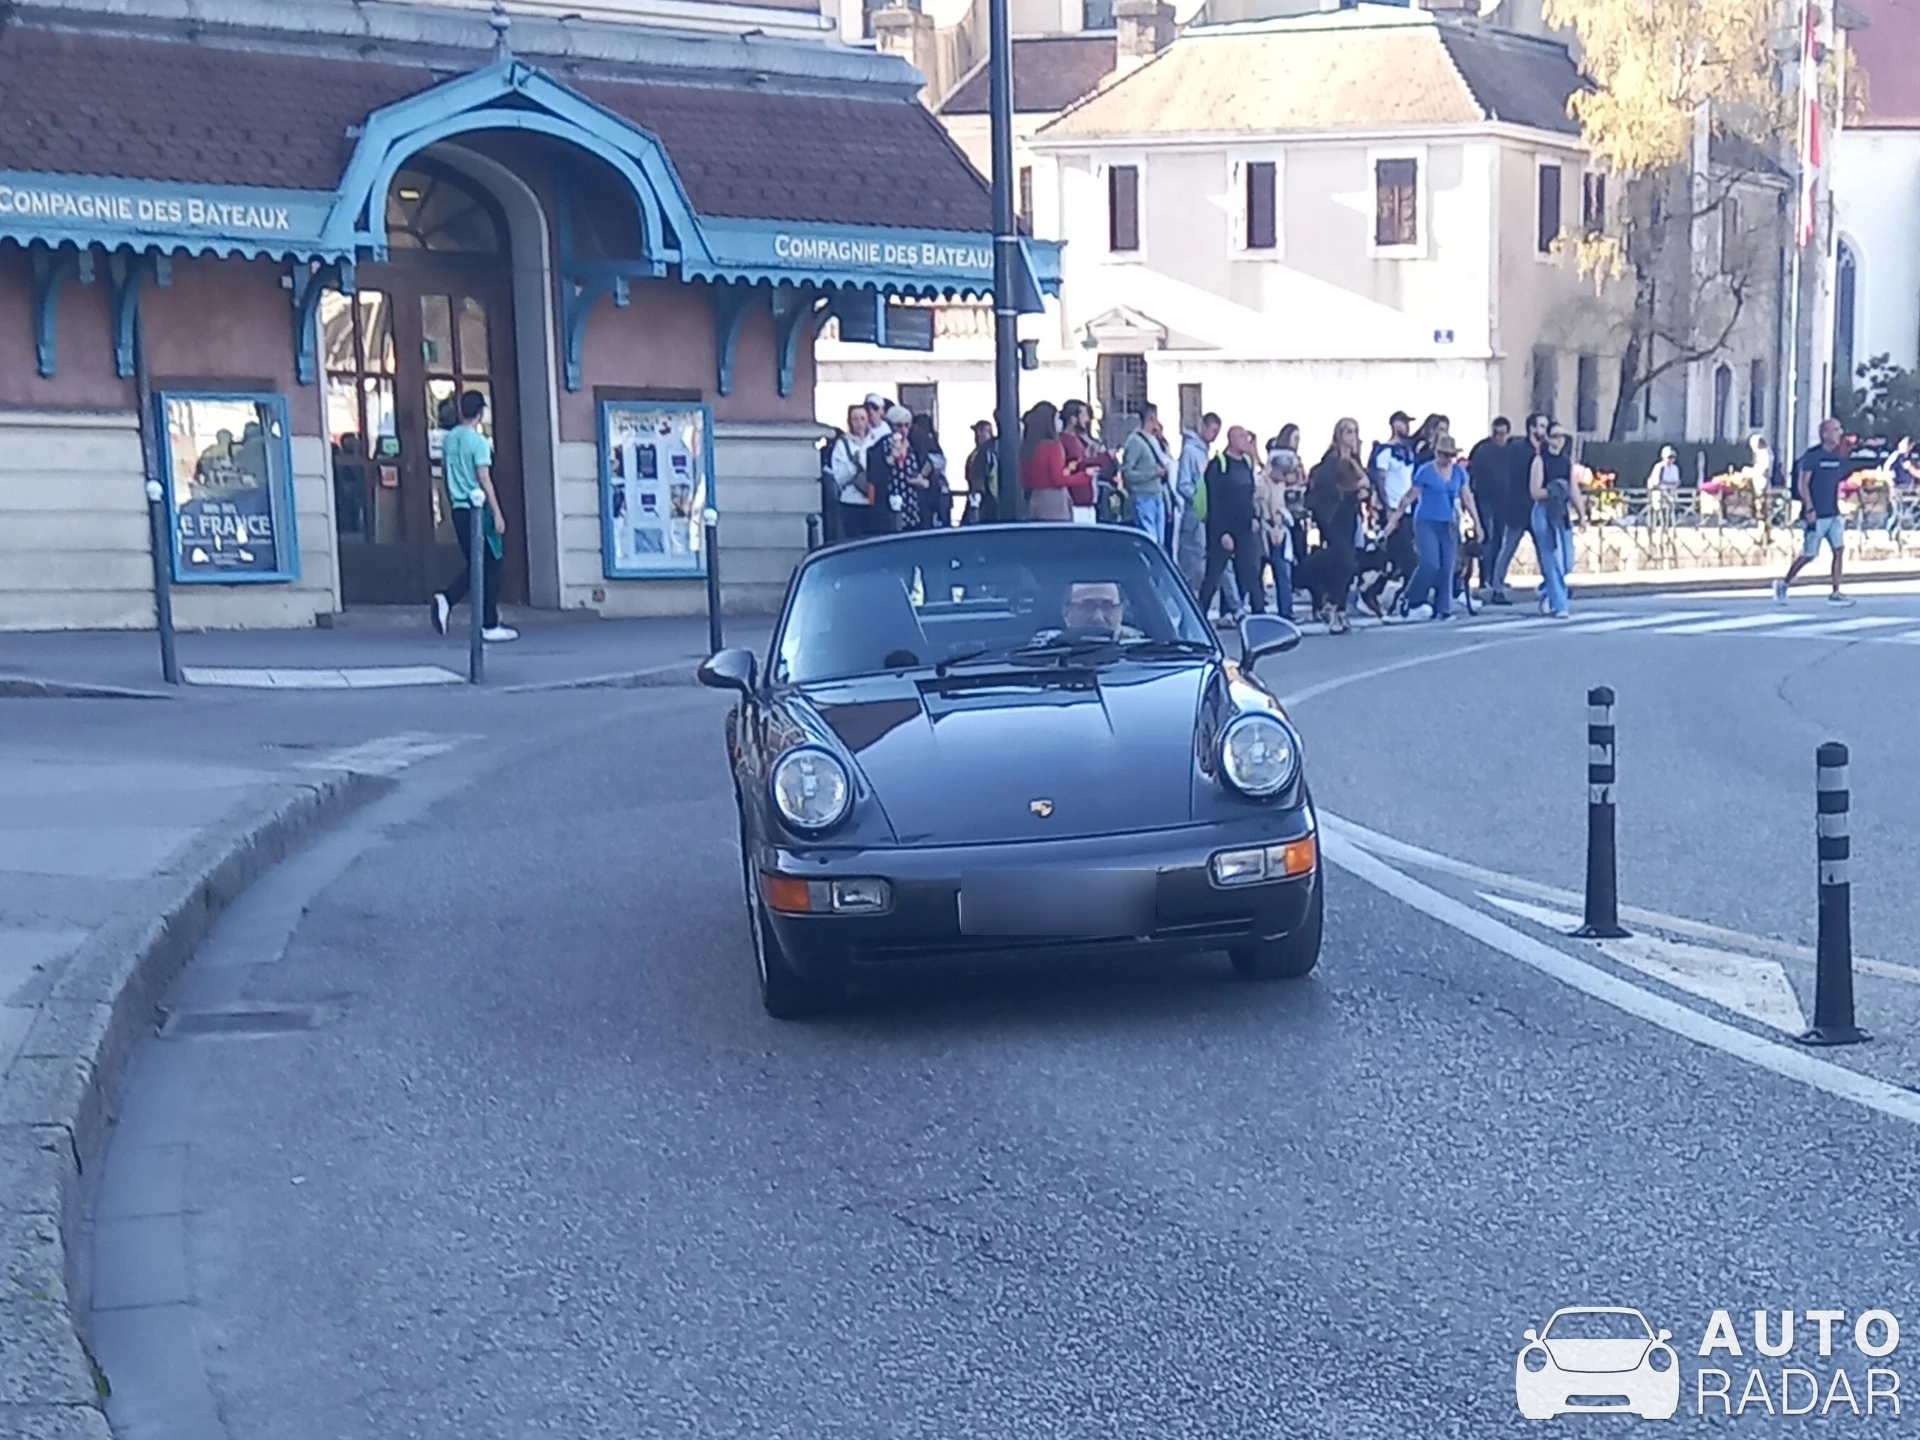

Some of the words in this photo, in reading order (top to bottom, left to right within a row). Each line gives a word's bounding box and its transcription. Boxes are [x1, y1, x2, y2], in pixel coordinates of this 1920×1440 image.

[0, 185, 132, 218] COMPAGNIE
[138, 202, 182, 223] DES
[188, 199, 289, 230] BATEAUX
[775, 235, 880, 262] COMPAGNIE
[885, 245, 918, 265] DES
[199, 514, 272, 537] FRANCE
